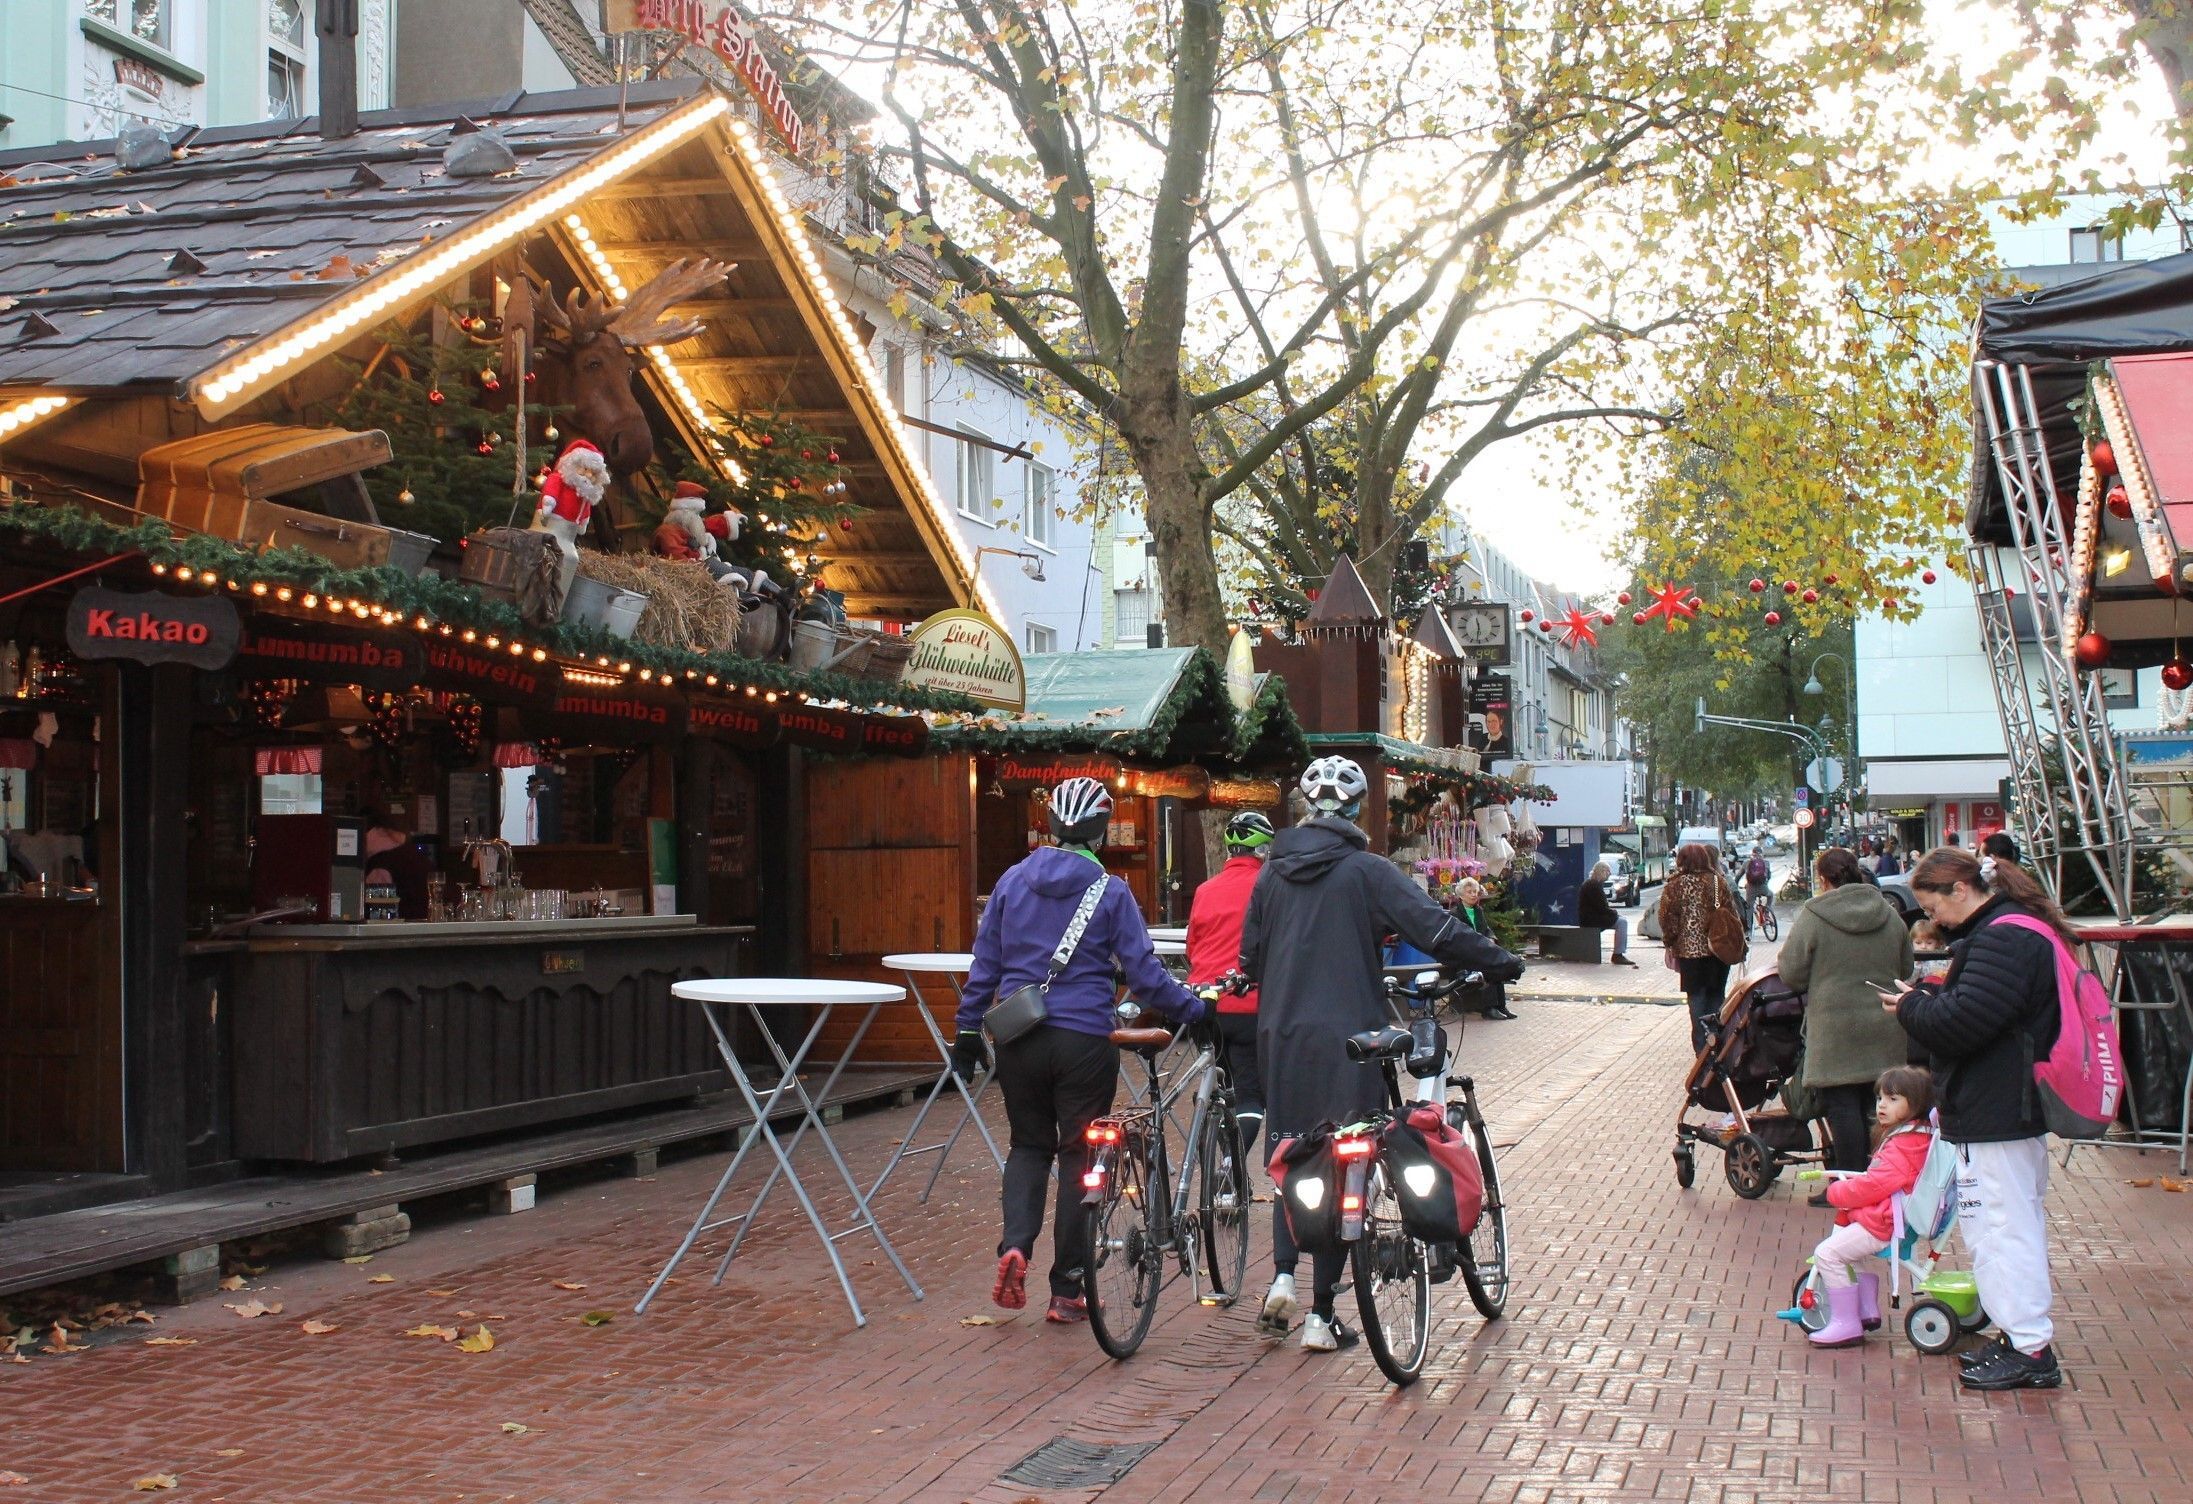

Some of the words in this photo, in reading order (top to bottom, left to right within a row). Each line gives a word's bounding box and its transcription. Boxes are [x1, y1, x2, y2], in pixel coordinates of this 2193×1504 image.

[87, 608, 209, 645] Kakao
[942, 623, 990, 652] Liesel's
[239, 631, 404, 668] Lumumba
[908, 640, 1016, 683] Glühweinhütte
[426, 641, 537, 693] ühwein
[924, 676, 937, 685] seit
[938, 677, 954, 688] über
[956, 680, 966, 691] 25
[967, 680, 994, 694] Jahren
[690, 706, 759, 732] wein
[778, 711, 847, 740] umba
[865, 722, 914, 745] ffee
[1002, 760, 1117, 784] Dampfnudeln
[1799, 813, 1809, 823] 30
